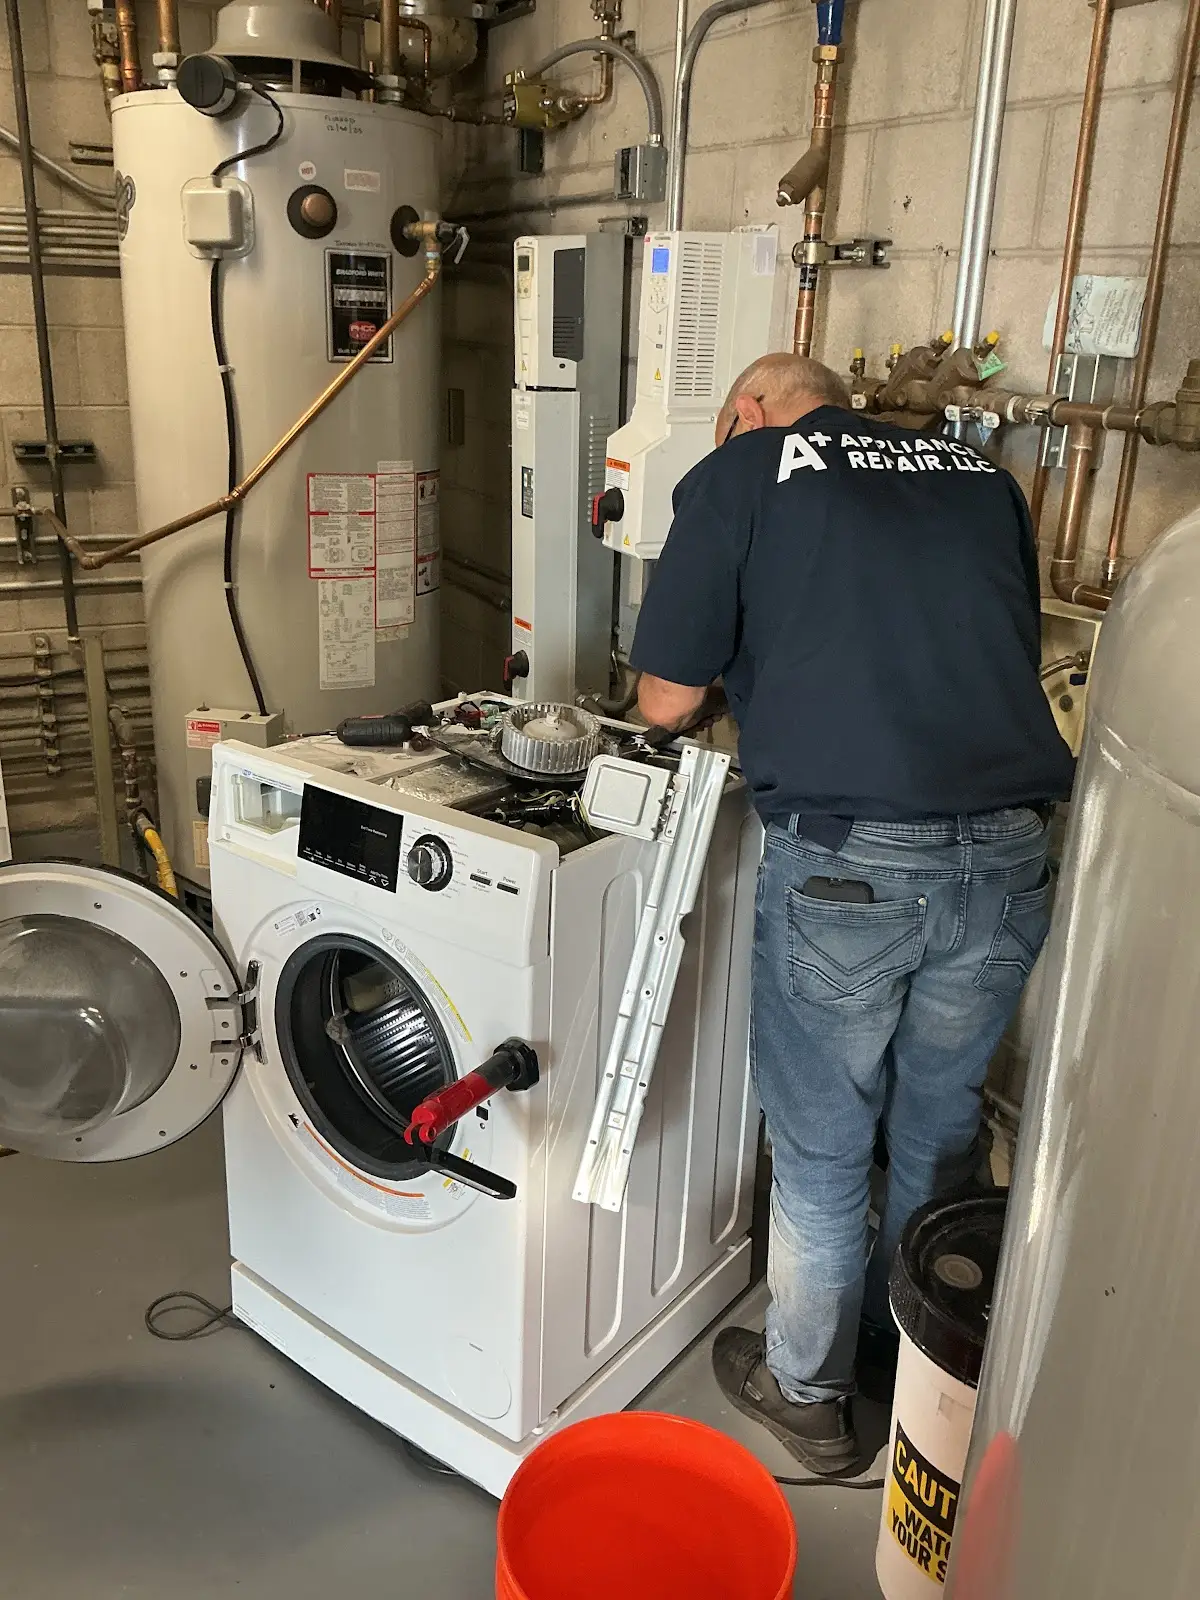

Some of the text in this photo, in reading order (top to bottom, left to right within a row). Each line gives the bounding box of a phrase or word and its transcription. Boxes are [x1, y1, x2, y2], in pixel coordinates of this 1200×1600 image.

[335, 268, 367, 277] BRADFORD
[776, 431, 833, 484] A+
[840, 433, 983, 460] APPLIANCE
[950, 454, 997, 473] LLC
[476, 868, 488, 876] Start
[502, 876, 517, 885] Power
[895, 1439, 957, 1520] CAUT
[892, 1506, 948, 1583] YOUR S
